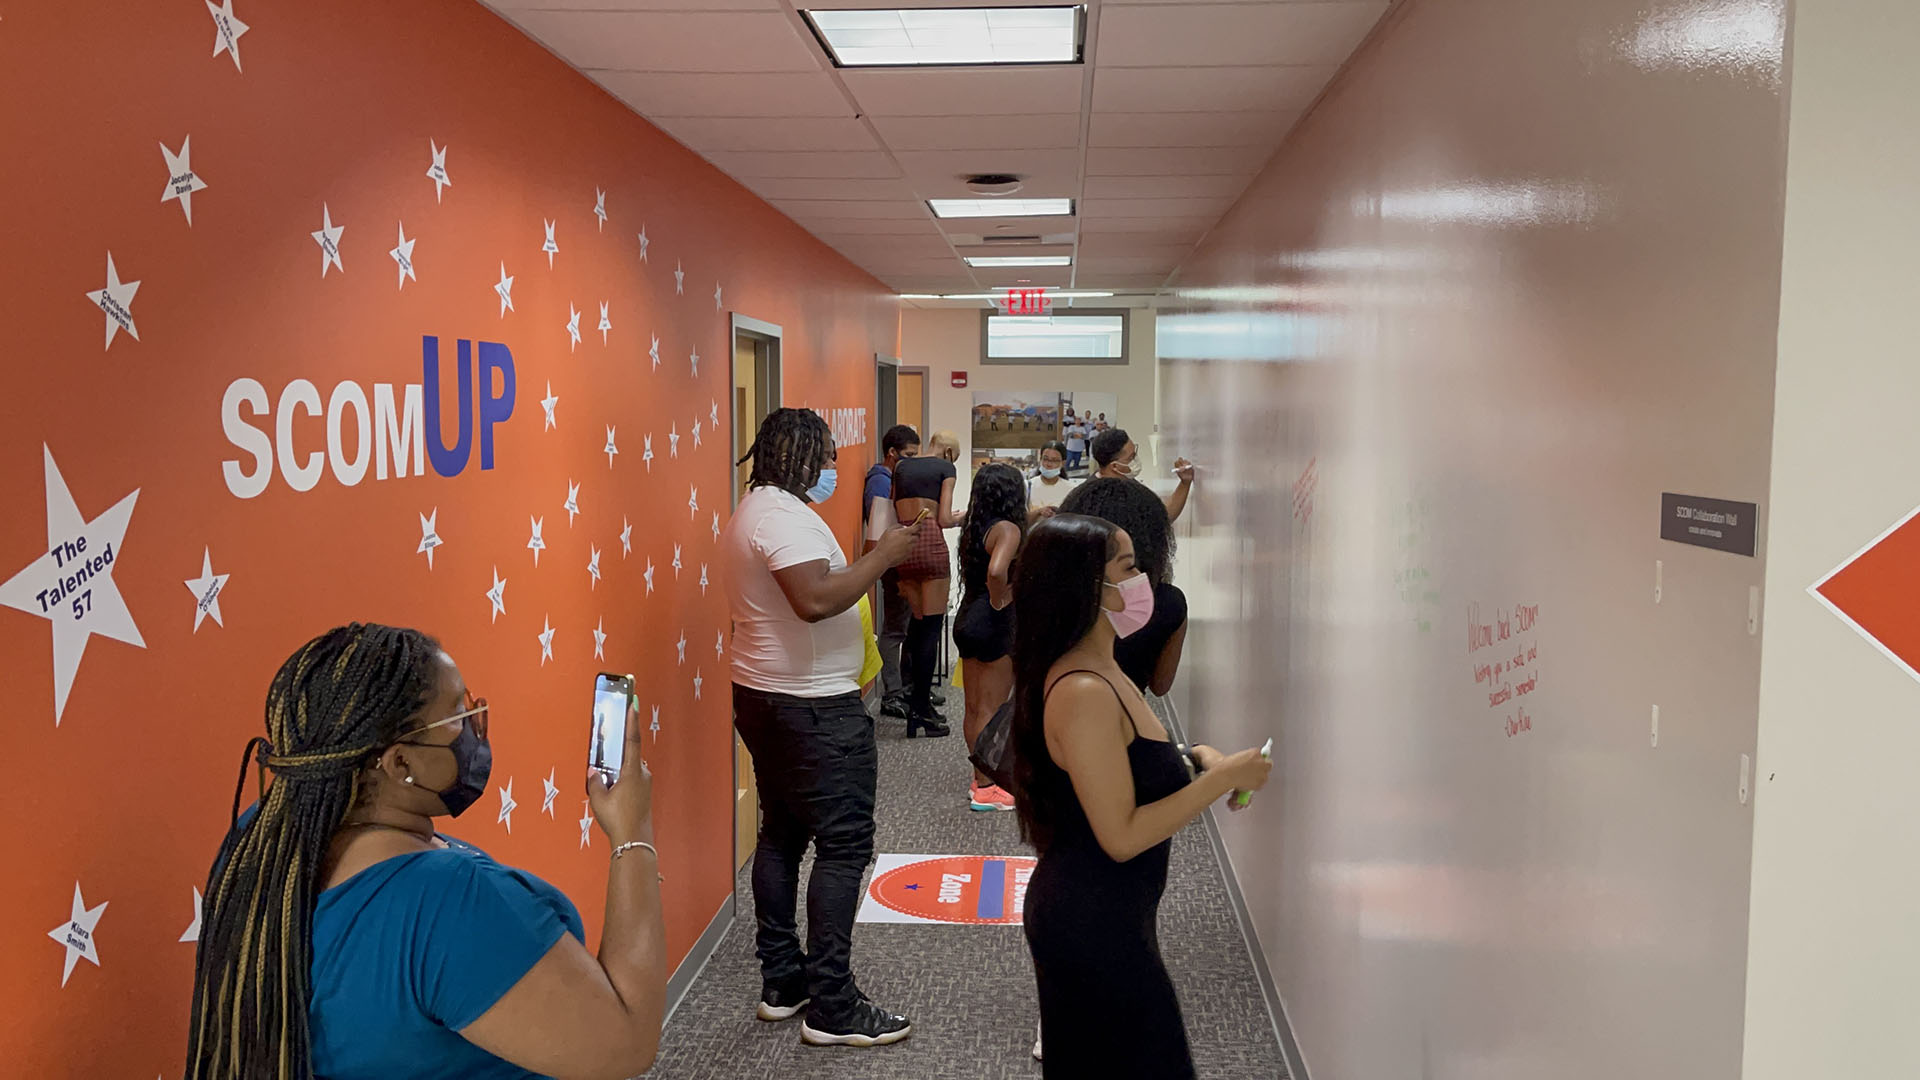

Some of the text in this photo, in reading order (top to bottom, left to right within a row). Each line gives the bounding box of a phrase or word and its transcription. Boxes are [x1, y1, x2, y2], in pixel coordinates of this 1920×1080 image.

[171, 172, 193, 185] Jocelyn
[175, 184, 192, 194] Davis
[100, 299, 129, 330] Hawkins
[102, 290, 132, 322] Chrisean
[1008, 288, 1045, 315] EXIT
[810, 407, 866, 448] ABORATE
[51, 536, 87, 568] The
[36, 542, 113, 613] Talented
[72, 589, 92, 620] 57
[937, 873, 972, 904] Zone
[66, 933, 86, 952] Smith
[71, 921, 89, 940] Kiara
